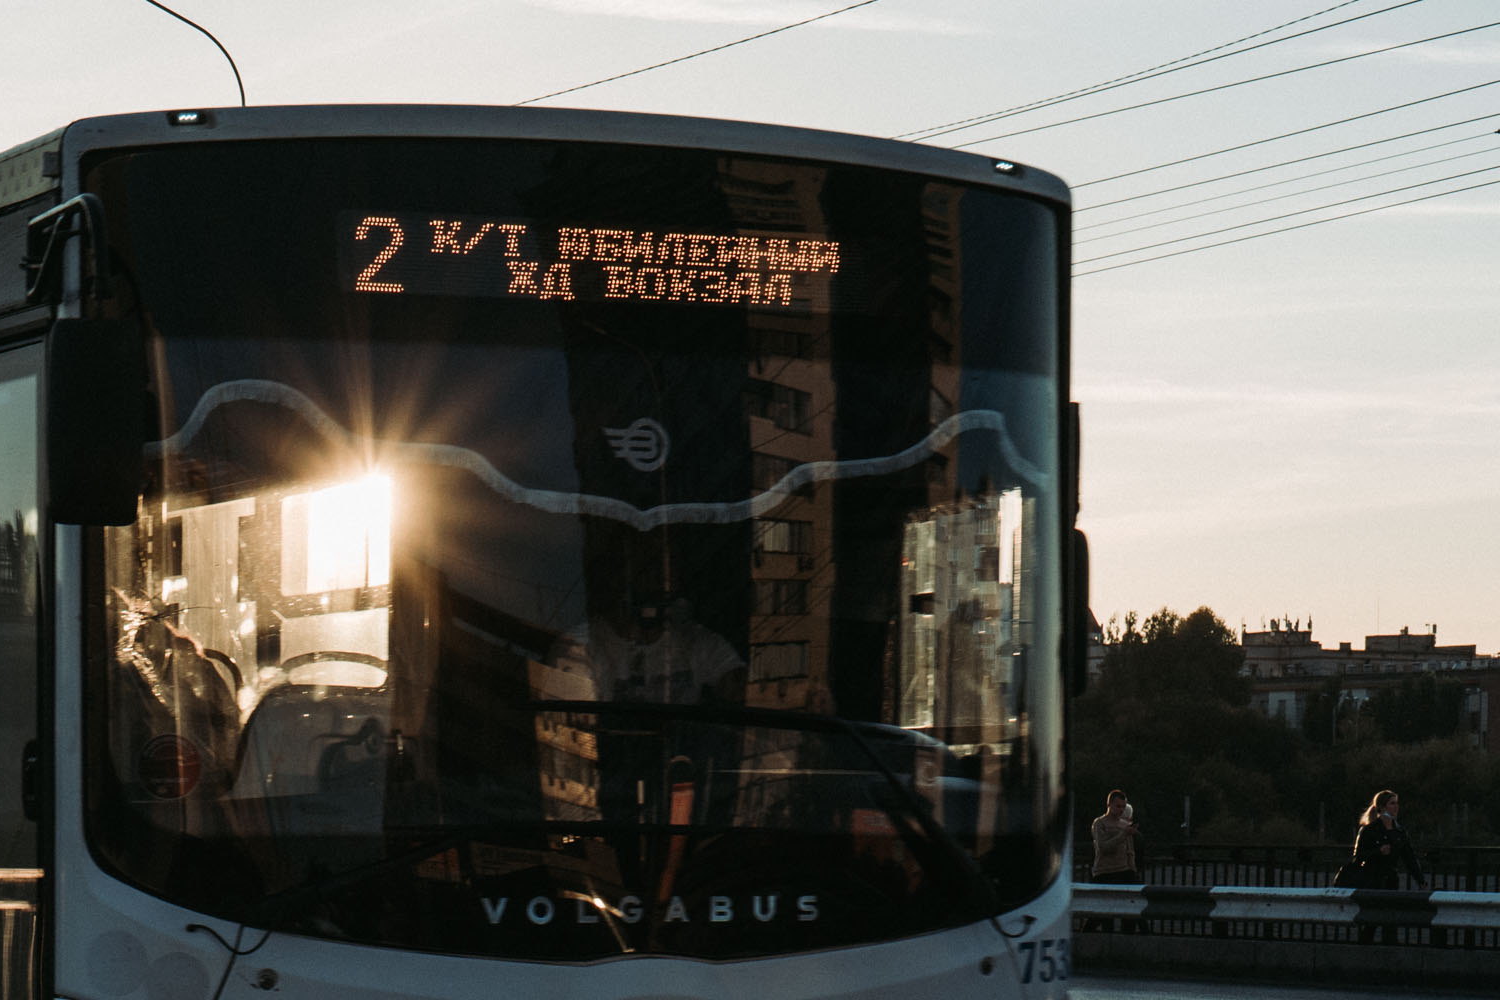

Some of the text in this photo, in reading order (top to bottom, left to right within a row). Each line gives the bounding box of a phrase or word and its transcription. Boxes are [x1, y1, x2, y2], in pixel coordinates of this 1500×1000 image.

[355, 216, 404, 293] 2
[428, 219, 840, 273] К/Т ЮБИЛЕЙНЫЙ
[506, 261, 792, 306] ЖД ВОКЗАЛ
[480, 894, 821, 926] VOLGABUS
